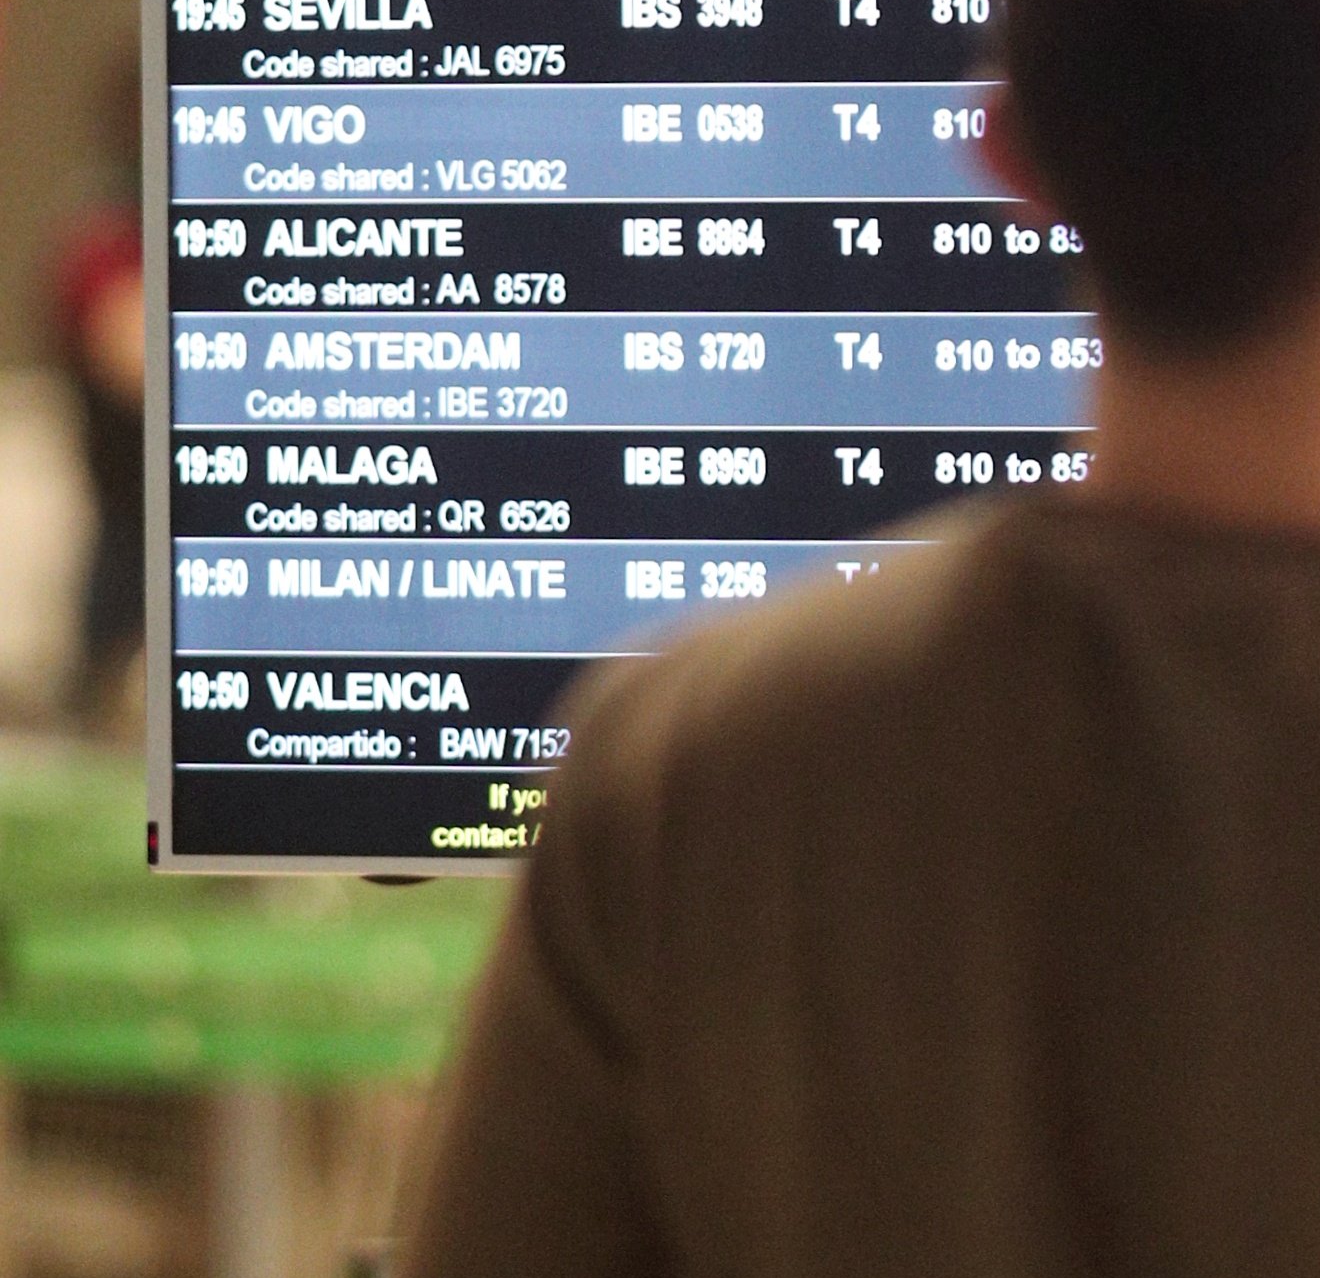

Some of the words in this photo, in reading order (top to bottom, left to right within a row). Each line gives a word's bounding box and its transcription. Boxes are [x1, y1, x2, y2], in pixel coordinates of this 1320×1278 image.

[171, 104, 248, 147] 19:45
[261, 103, 367, 146] VIGO
[620, 103, 684, 144] IBE
[695, 102, 765, 144] 0538
[173, 218, 247, 258] 19:50
[263, 217, 465, 258] ALICANTE
[622, 217, 685, 257] IBE
[832, 217, 883, 257] T4
[932, 221, 993, 256] 810
[1002, 222, 1042, 256] to
[1048, 223, 1085, 255] 85
[173, 330, 248, 372] 19:50
[263, 329, 522, 373] AMSTERDAM
[622, 330, 686, 373] IBS
[697, 331, 767, 372] 3720
[174, 444, 249, 485] 19:50
[266, 444, 439, 486] MALAGA
[624, 446, 686, 486] IBE
[698, 446, 767, 486] 8950
[174, 556, 250, 599] 19:50
[266, 557, 391, 599] MILAN
[421, 558, 568, 600] LINATE
[624, 559, 687, 601] IBE
[699, 560, 768, 600] 3256
[176, 670, 250, 711] 19:50
[266, 671, 471, 712] VALENCIA
[245, 726, 403, 765] Compartido
[439, 726, 508, 761] BAW
[510, 726, 572, 760] 7152
[488, 782, 511, 811] If
[430, 823, 529, 850] contact
